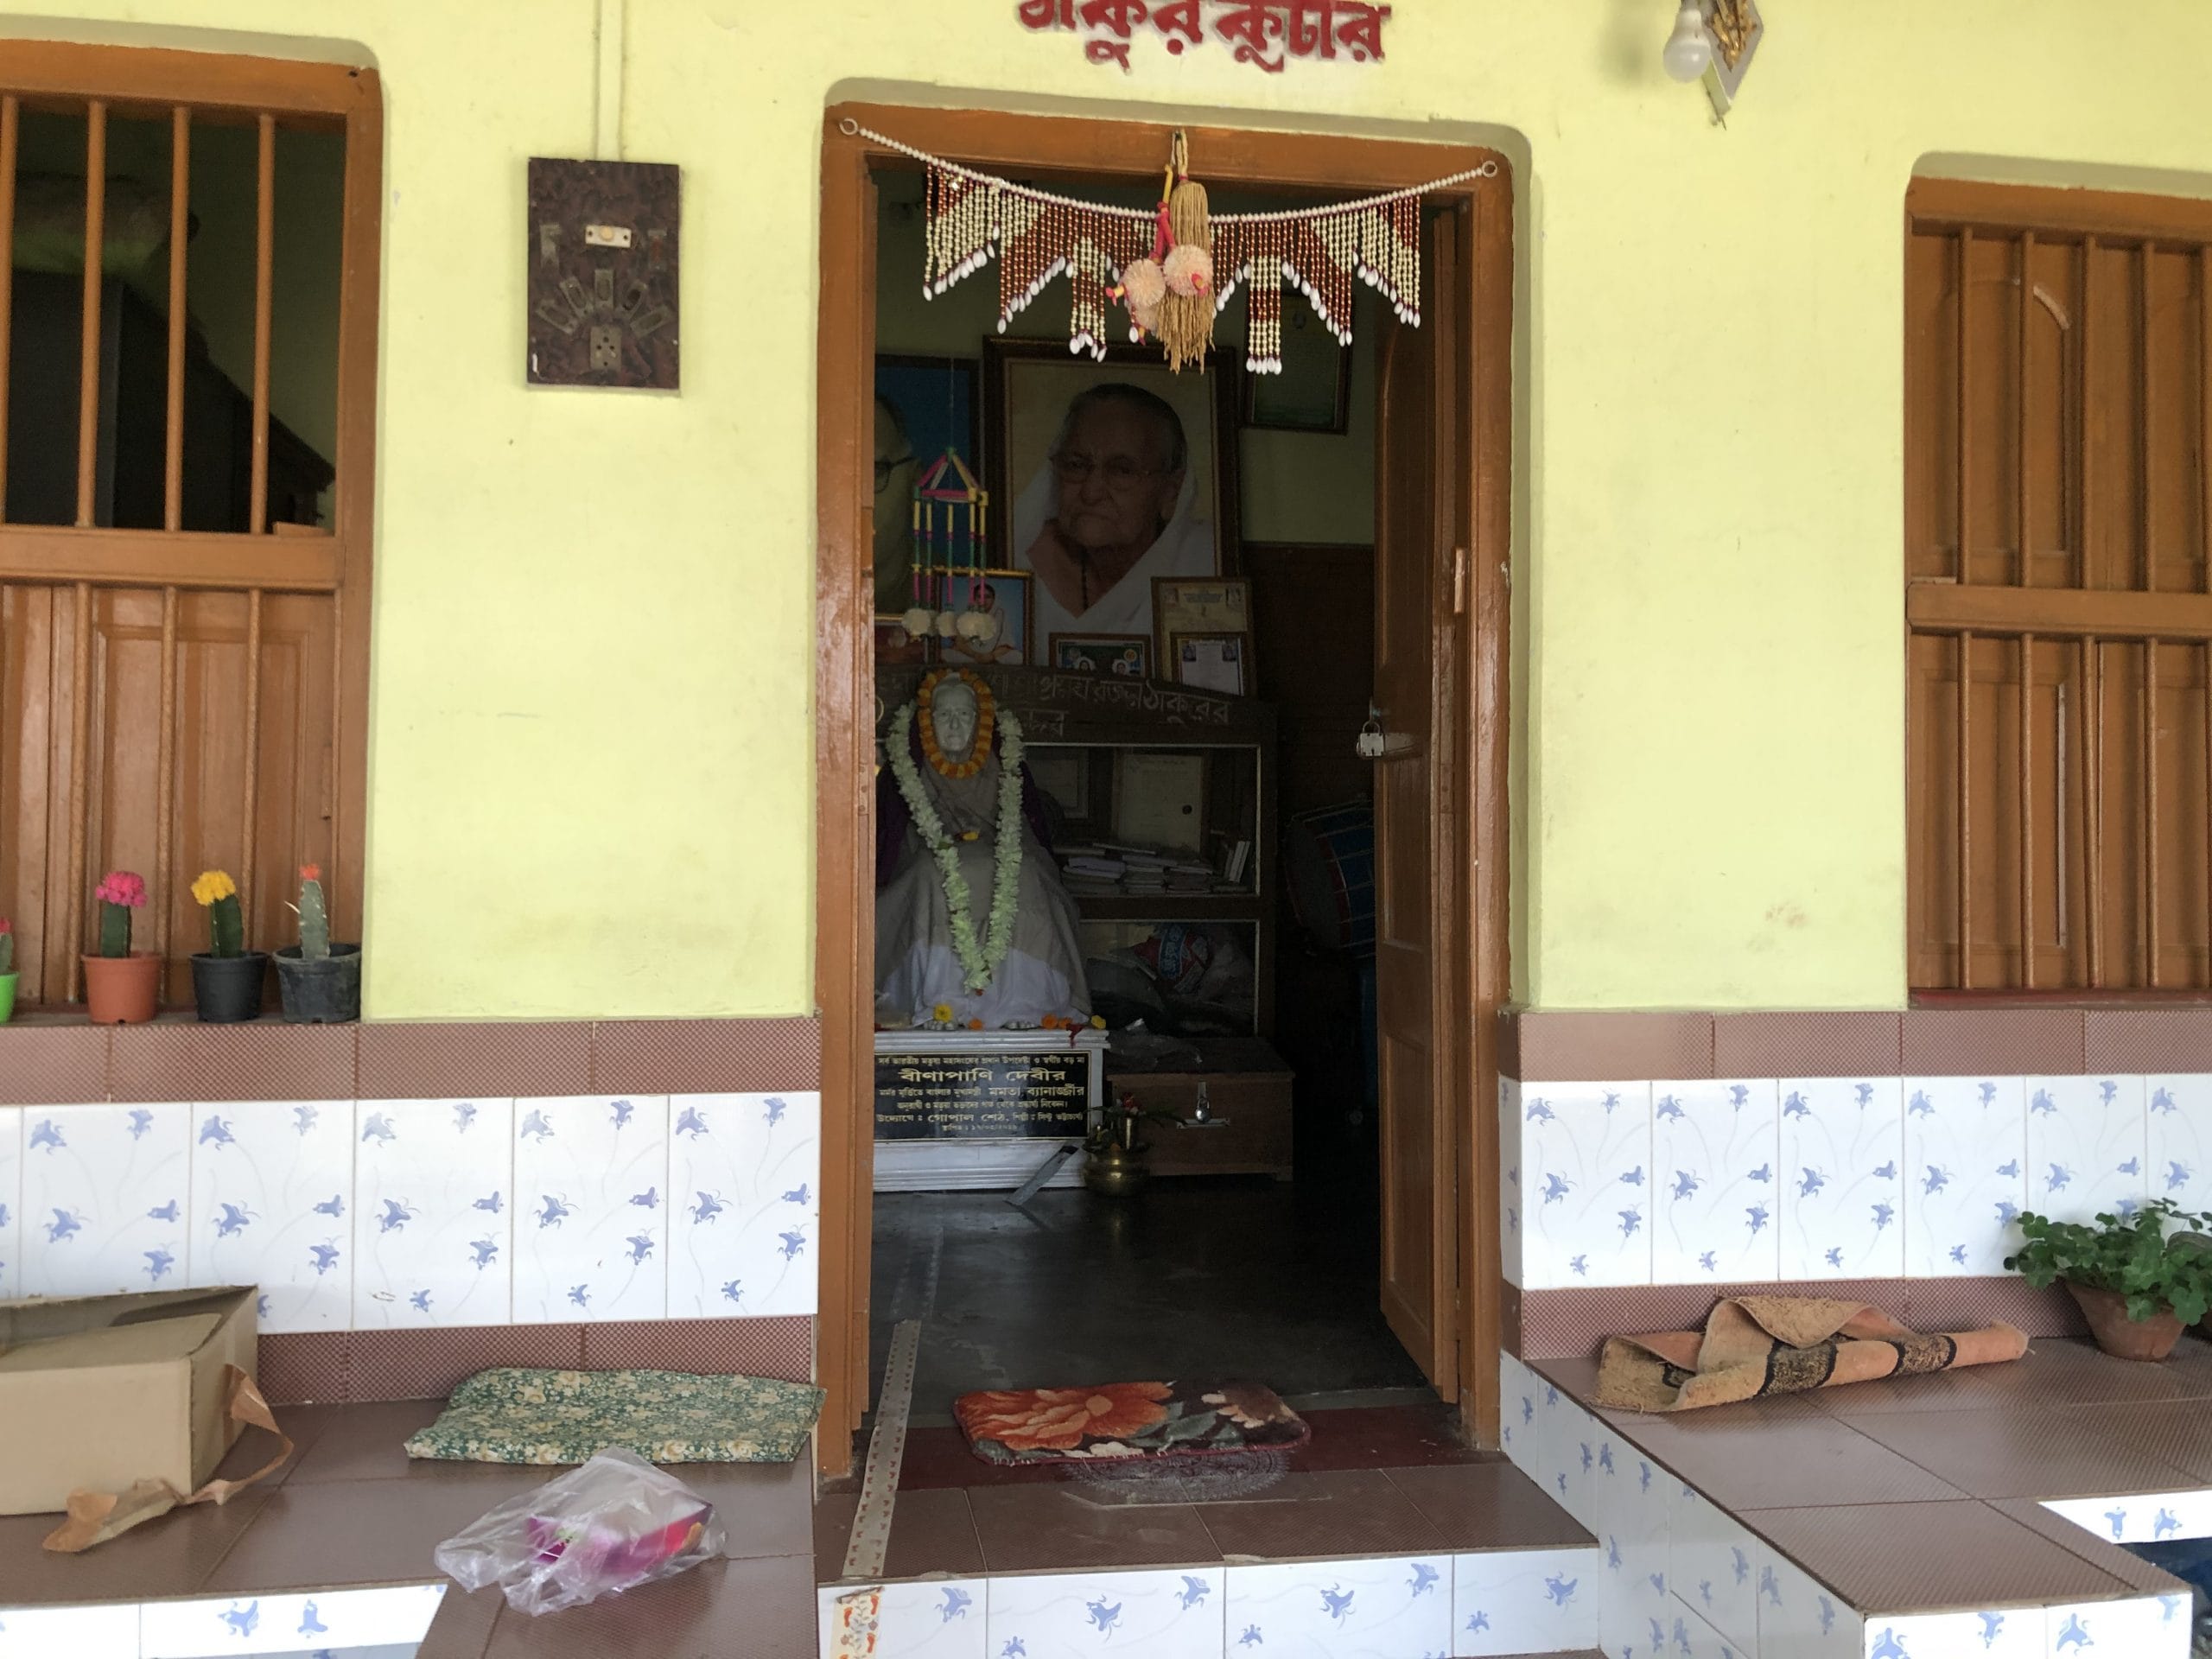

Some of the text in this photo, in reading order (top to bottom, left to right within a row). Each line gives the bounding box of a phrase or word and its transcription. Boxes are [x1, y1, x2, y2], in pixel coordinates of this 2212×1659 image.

[898, 1066, 1066, 1082] বীণাপাণি দেবীর
[988, 1086, 1020, 1096] মমতা
[927, 1114, 974, 1122] গোপাল
